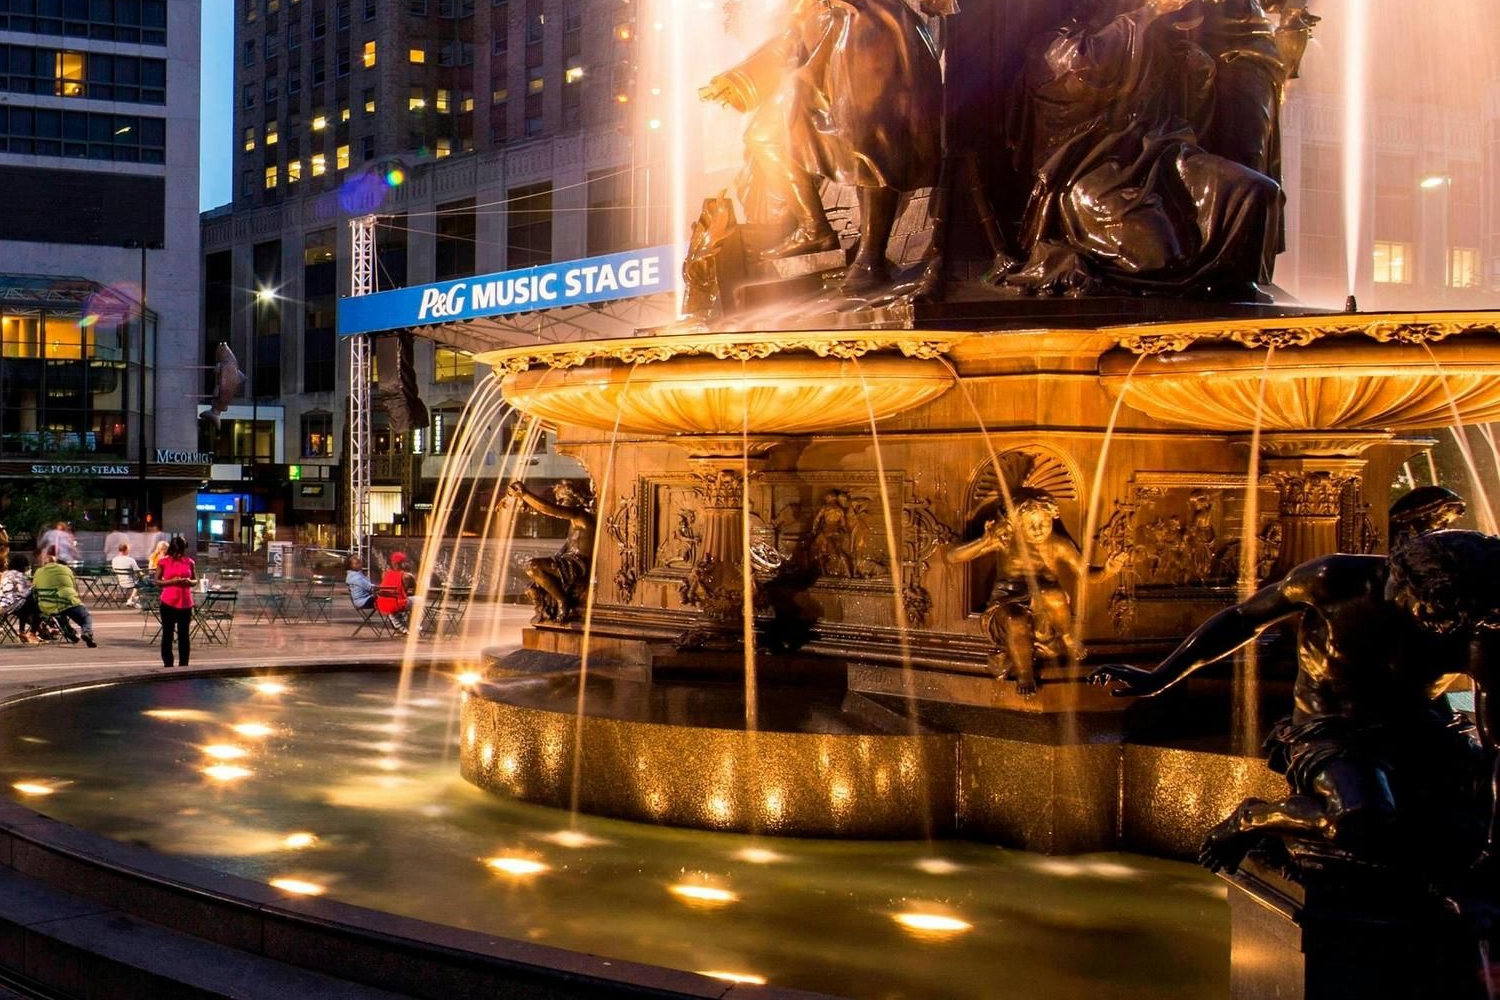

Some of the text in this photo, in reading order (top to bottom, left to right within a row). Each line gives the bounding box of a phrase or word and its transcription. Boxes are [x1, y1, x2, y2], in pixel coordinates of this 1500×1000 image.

[418, 256, 660, 320] P&G MUSIC STAGE
[91, 465, 129, 474] STEAKS
